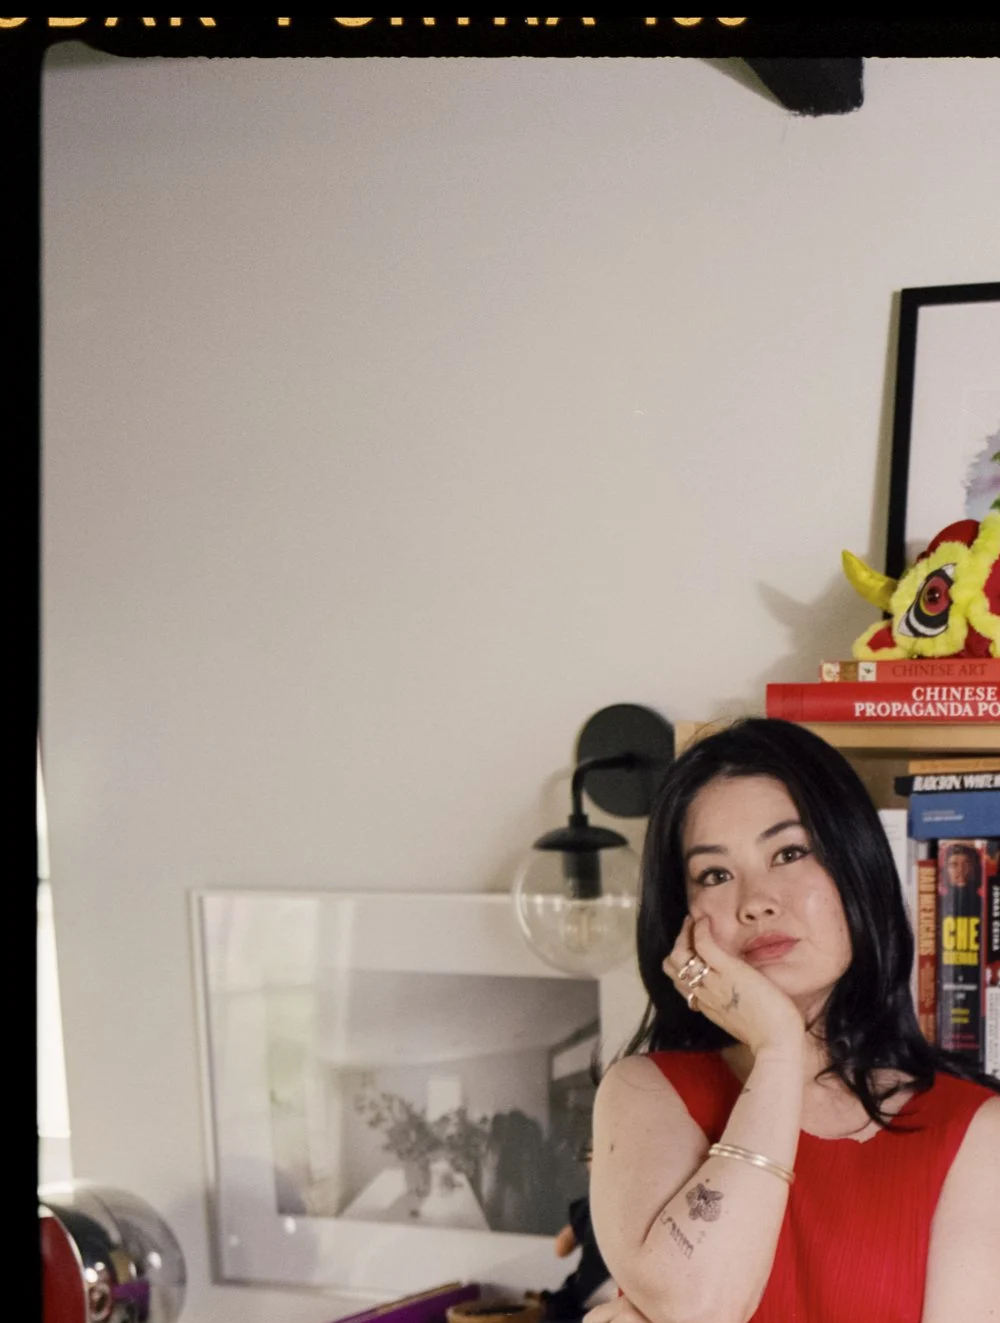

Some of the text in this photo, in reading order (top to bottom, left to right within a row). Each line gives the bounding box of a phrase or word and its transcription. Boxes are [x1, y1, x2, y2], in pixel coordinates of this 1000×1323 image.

[891, 663, 988, 678] CHINESE ART
[911, 686, 998, 701] CHINESE
[854, 702, 974, 717] PROPAGANDA
[918, 867, 936, 956] BAD MEXICANS
[992, 886, 1000, 917] JONAS
[942, 917, 980, 951] CHE
